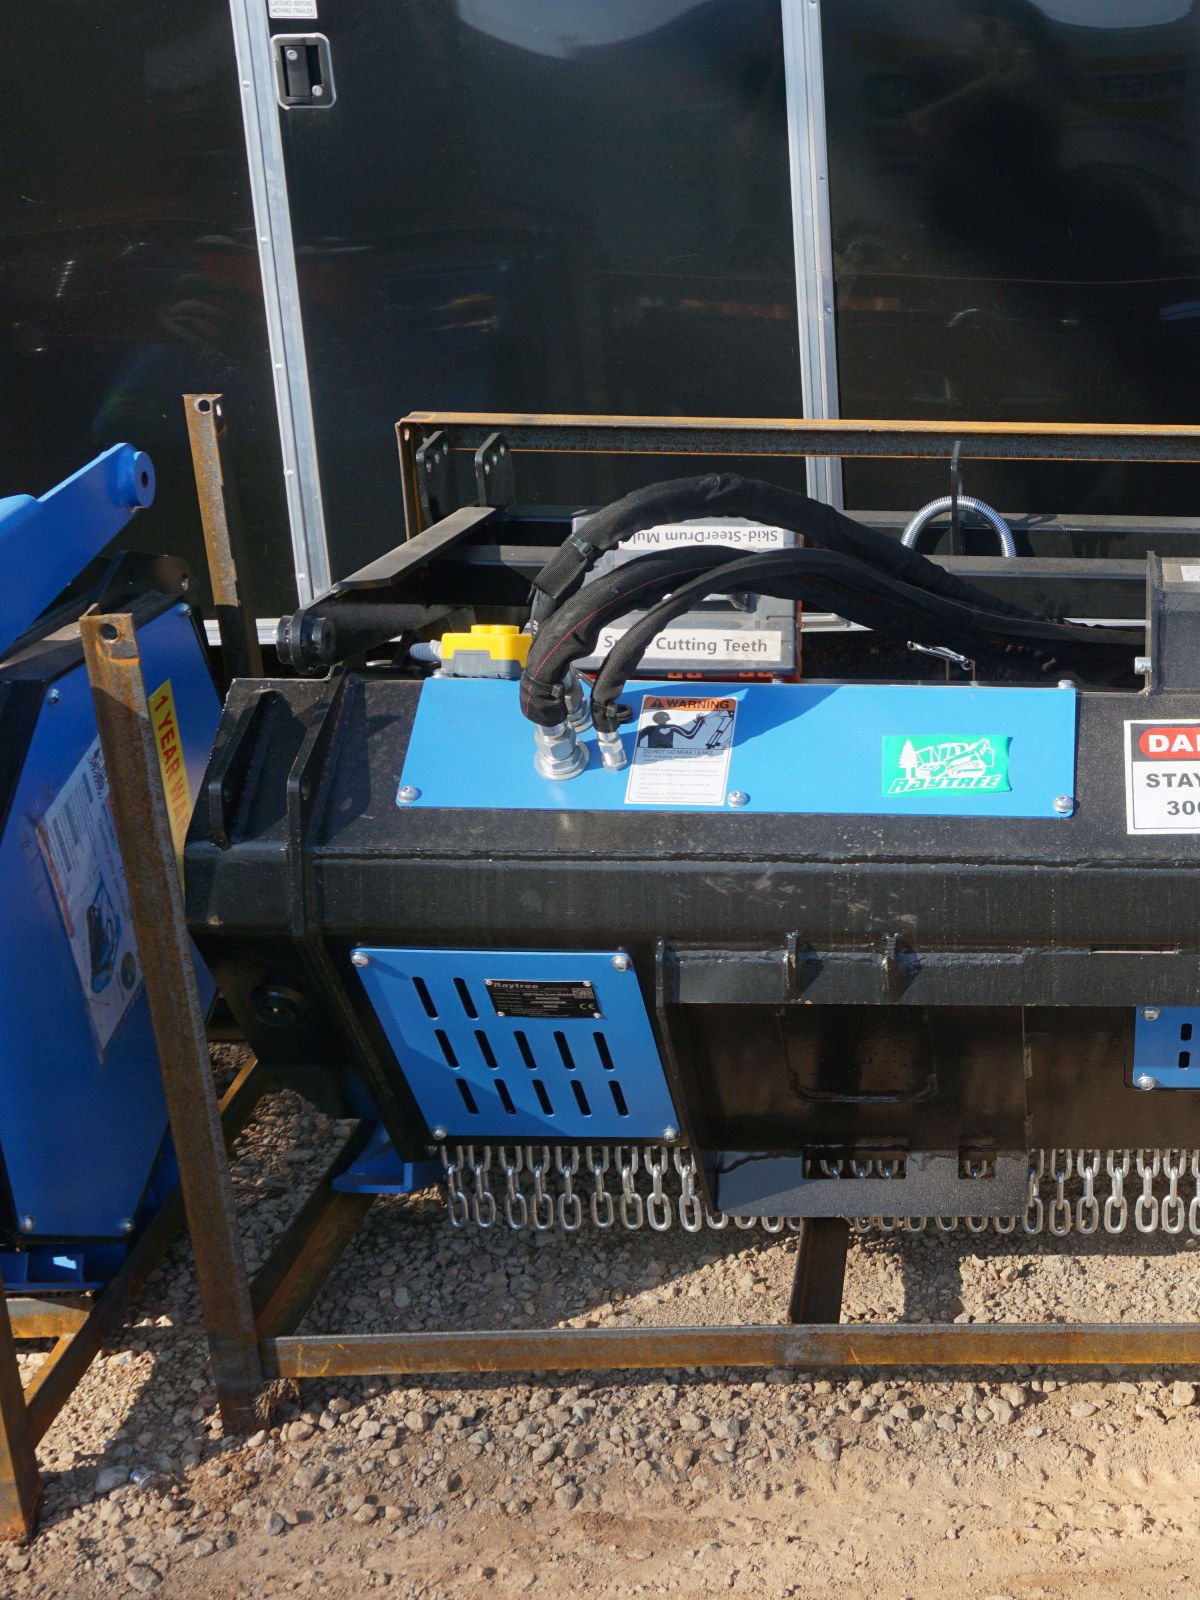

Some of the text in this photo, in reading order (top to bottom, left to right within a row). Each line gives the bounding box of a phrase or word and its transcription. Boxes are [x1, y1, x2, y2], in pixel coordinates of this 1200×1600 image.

[633, 530, 660, 544] Mul
[656, 637, 717, 654] Cutting
[723, 638, 767, 653] Teeth
[667, 699, 730, 709] WARNING
[157, 710, 182, 782] YEAR
